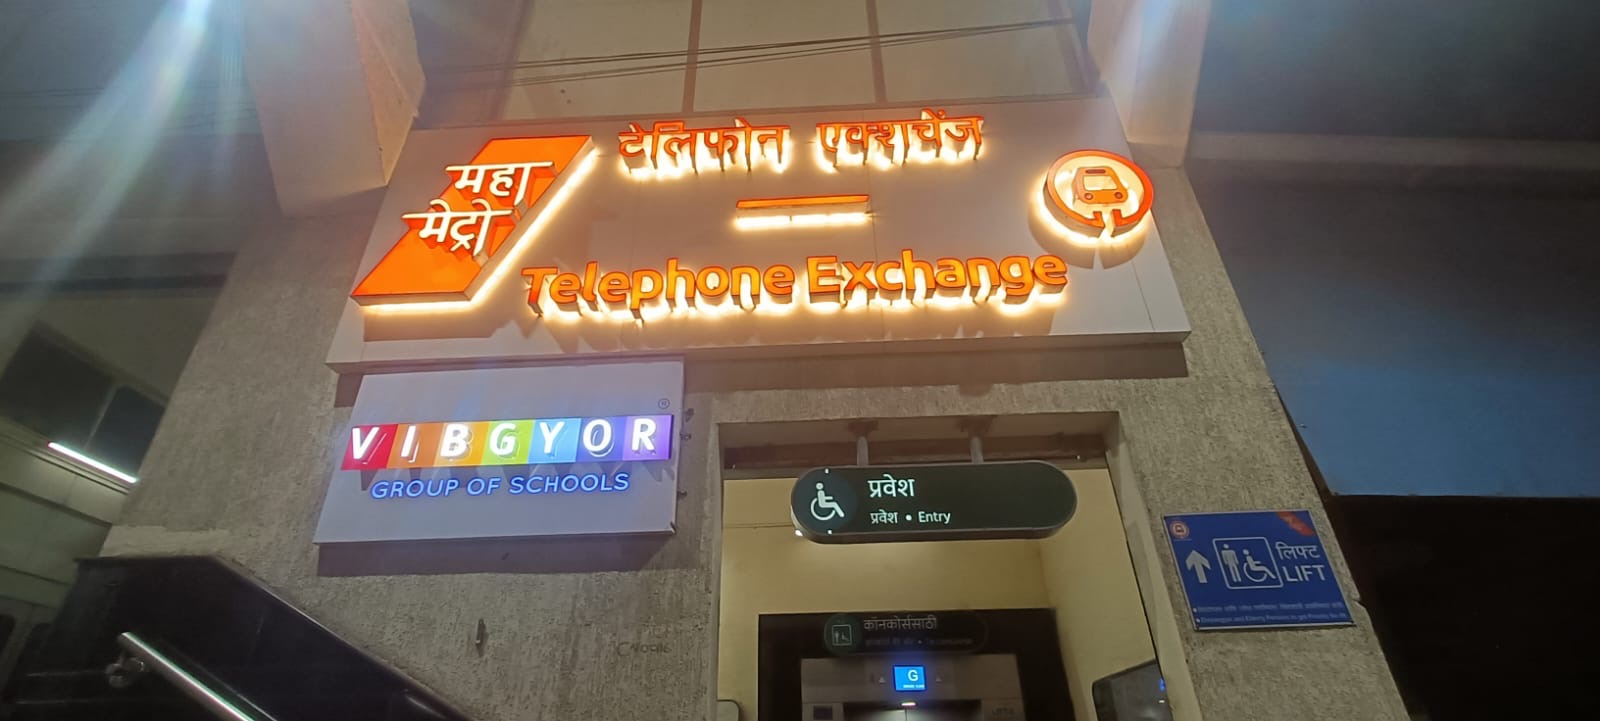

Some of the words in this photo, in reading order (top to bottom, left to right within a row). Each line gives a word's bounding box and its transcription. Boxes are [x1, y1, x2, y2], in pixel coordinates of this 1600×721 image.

[618, 115, 791, 165] टेलिफोन
[445, 161, 553, 206] महा
[401, 198, 513, 256] मेट्रो
[521, 256, 794, 312] Telephone
[807, 249, 1067, 302] Exchange
[351, 418, 658, 460] VIBGYOR
[371, 479, 459, 499] GROUP
[467, 477, 501, 496] OF
[509, 473, 630, 495] SCHOOLS
[867, 474, 915, 498] प्रवेश
[870, 508, 898, 525] प्रवेश
[918, 510, 951, 525] Entry
[1275, 541, 1321, 560] लिफ्ट
[1282, 564, 1325, 582] LIFT
[907, 669, 919, 682] G
